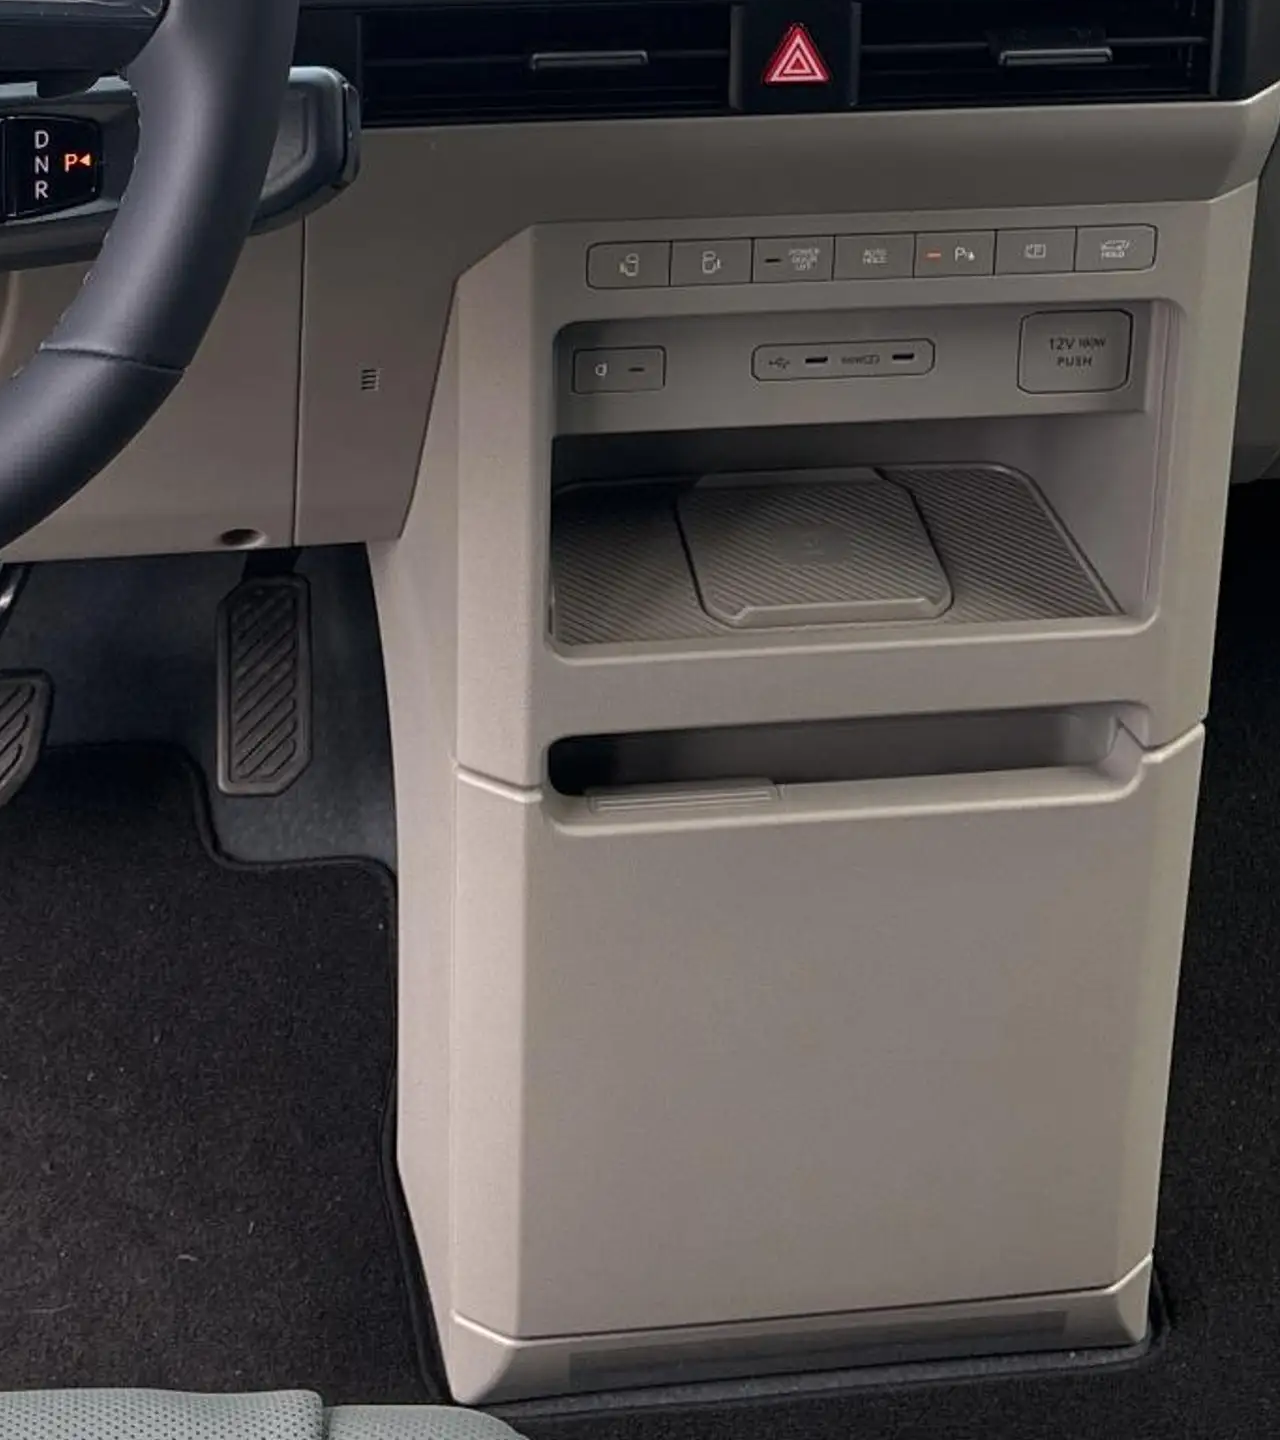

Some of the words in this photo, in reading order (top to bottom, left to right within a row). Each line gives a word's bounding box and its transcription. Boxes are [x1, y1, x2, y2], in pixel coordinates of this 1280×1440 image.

[34, 129, 50, 150] D
[34, 156, 50, 174] N
[64, 153, 78, 172] P
[34, 181, 49, 200] R
[1049, 337, 1075, 350] 12V
[1056, 356, 1093, 368] PUSH
